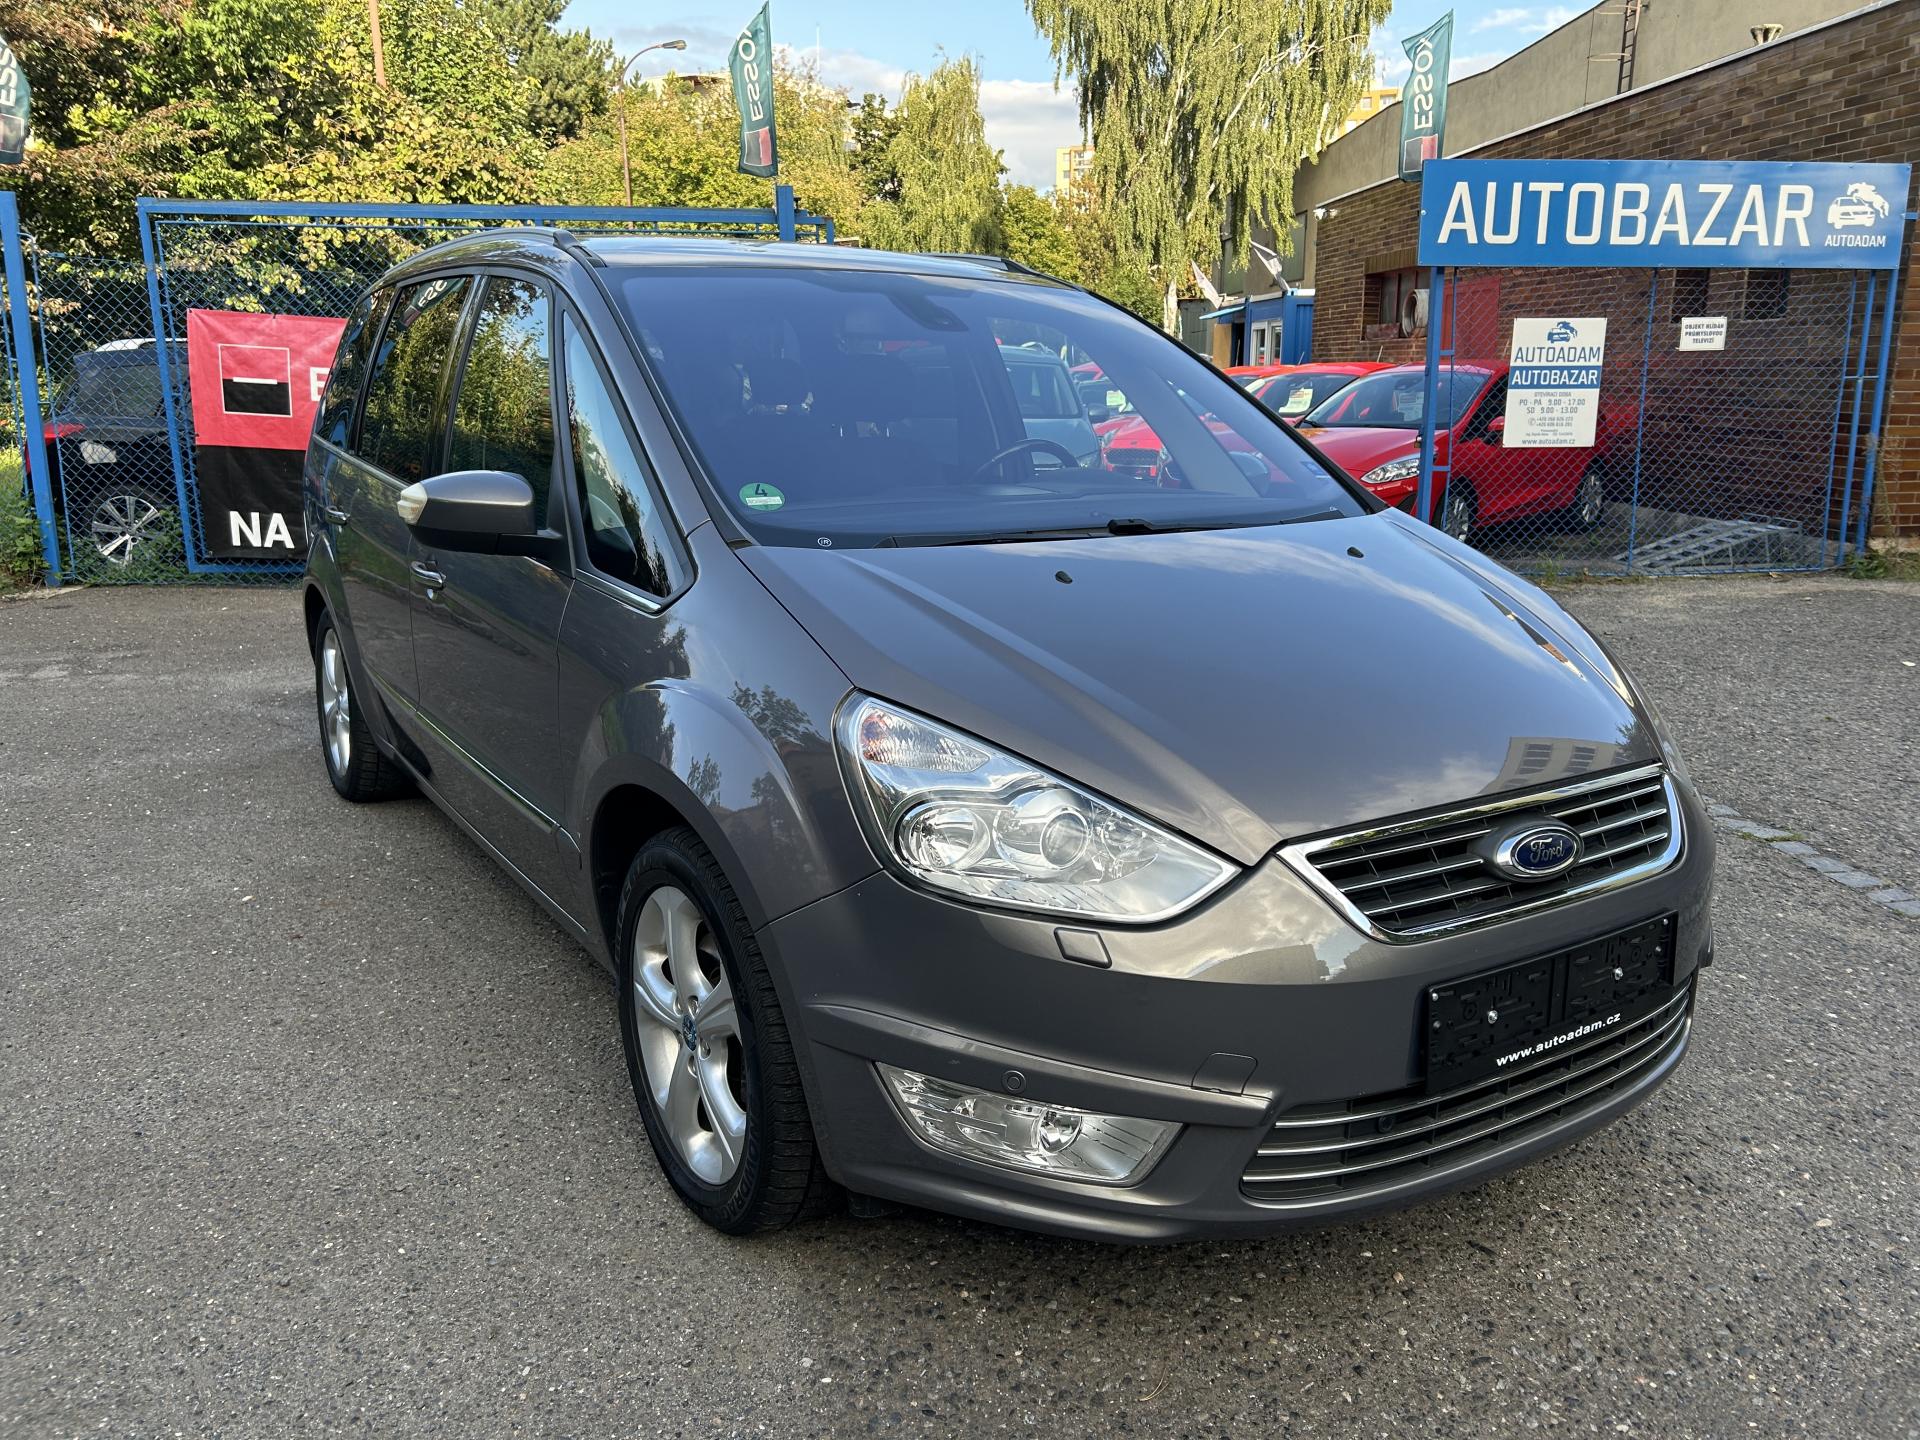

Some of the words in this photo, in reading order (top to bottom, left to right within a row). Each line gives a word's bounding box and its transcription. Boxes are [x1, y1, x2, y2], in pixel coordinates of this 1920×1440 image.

[1437, 181, 1814, 247] AUTOBAZAR
[1823, 234, 1887, 248] AUTOADAM
[1514, 346, 1601, 363] AUTOADAM
[1511, 369, 1598, 386] AUTOBAZAR
[755, 484, 768, 496] 4
[229, 511, 295, 549] NA
[1530, 837, 1564, 863] Ford
[1496, 1012, 1621, 1067] www.autoadam.cz
